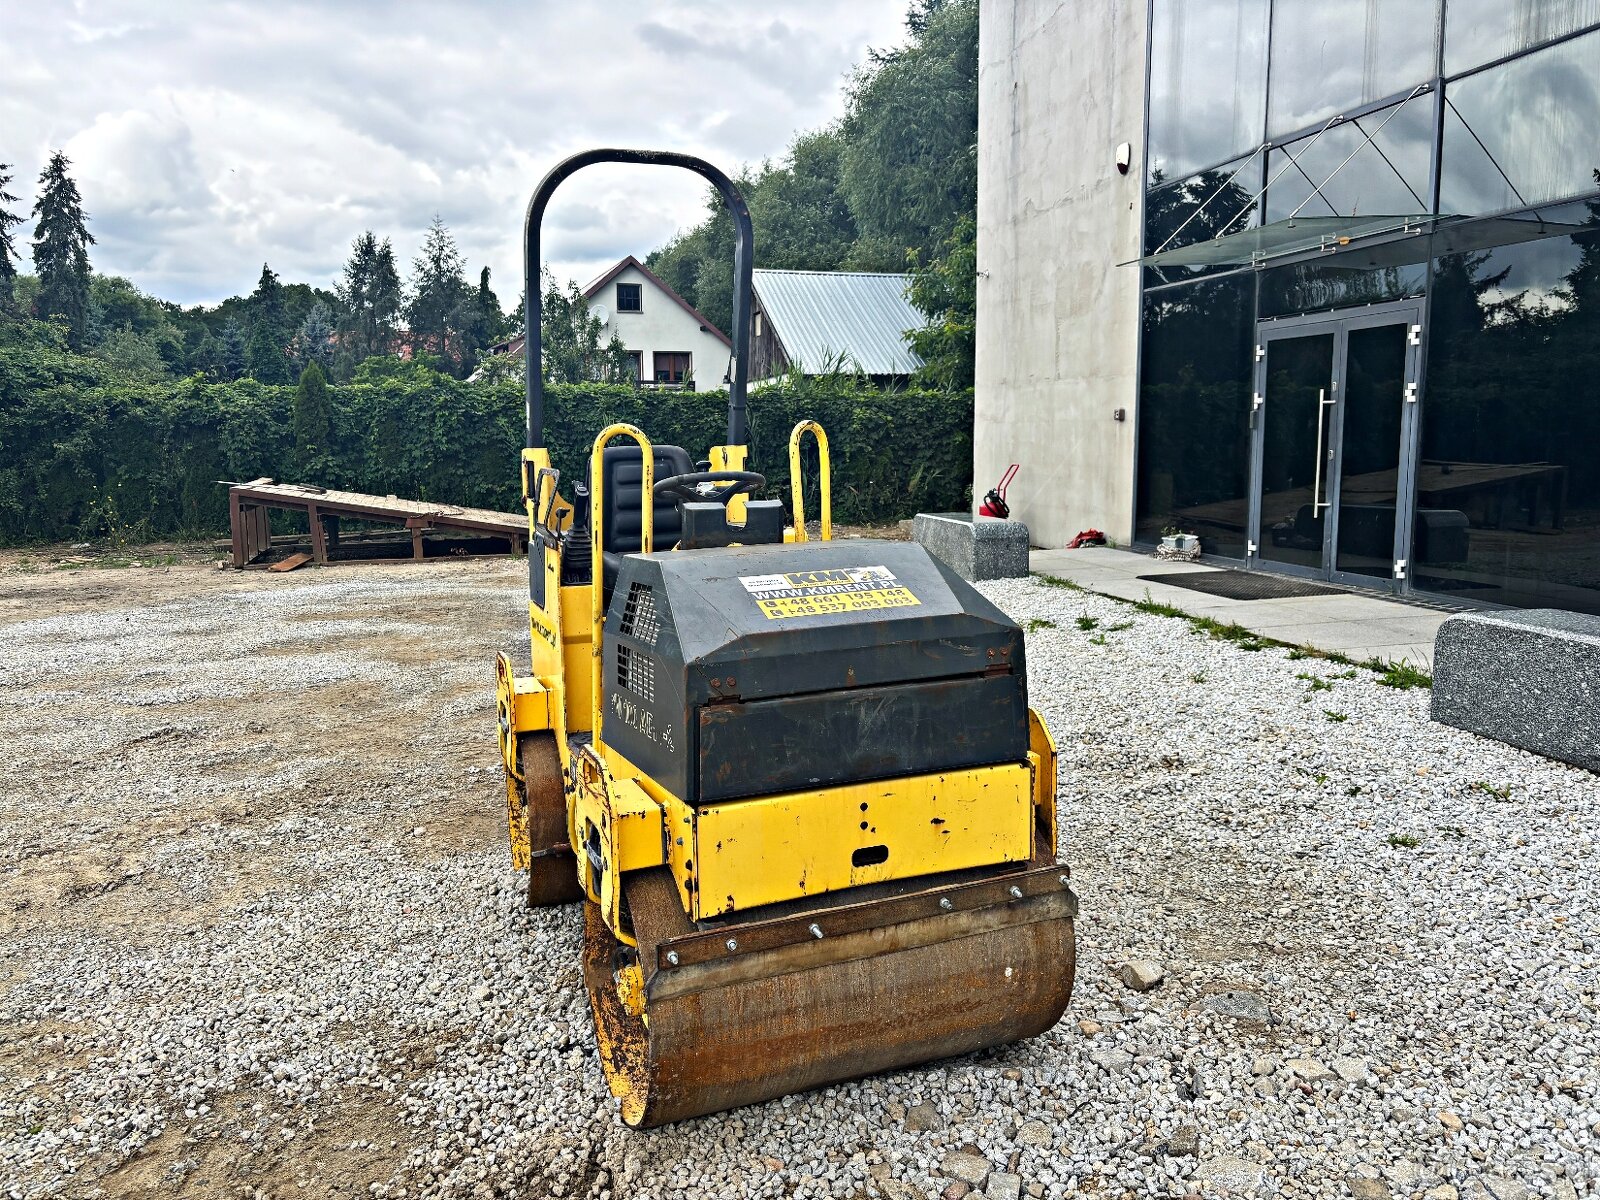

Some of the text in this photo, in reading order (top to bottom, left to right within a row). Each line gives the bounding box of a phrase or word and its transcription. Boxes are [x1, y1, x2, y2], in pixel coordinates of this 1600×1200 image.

[788, 570, 851, 585] KM
[751, 579, 903, 600] WWW.KMRENT.PL
[813, 594, 841, 604] 661
[845, 592, 874, 601] 195
[878, 589, 906, 598] 148
[821, 603, 847, 613] 537
[852, 600, 881, 609] 003
